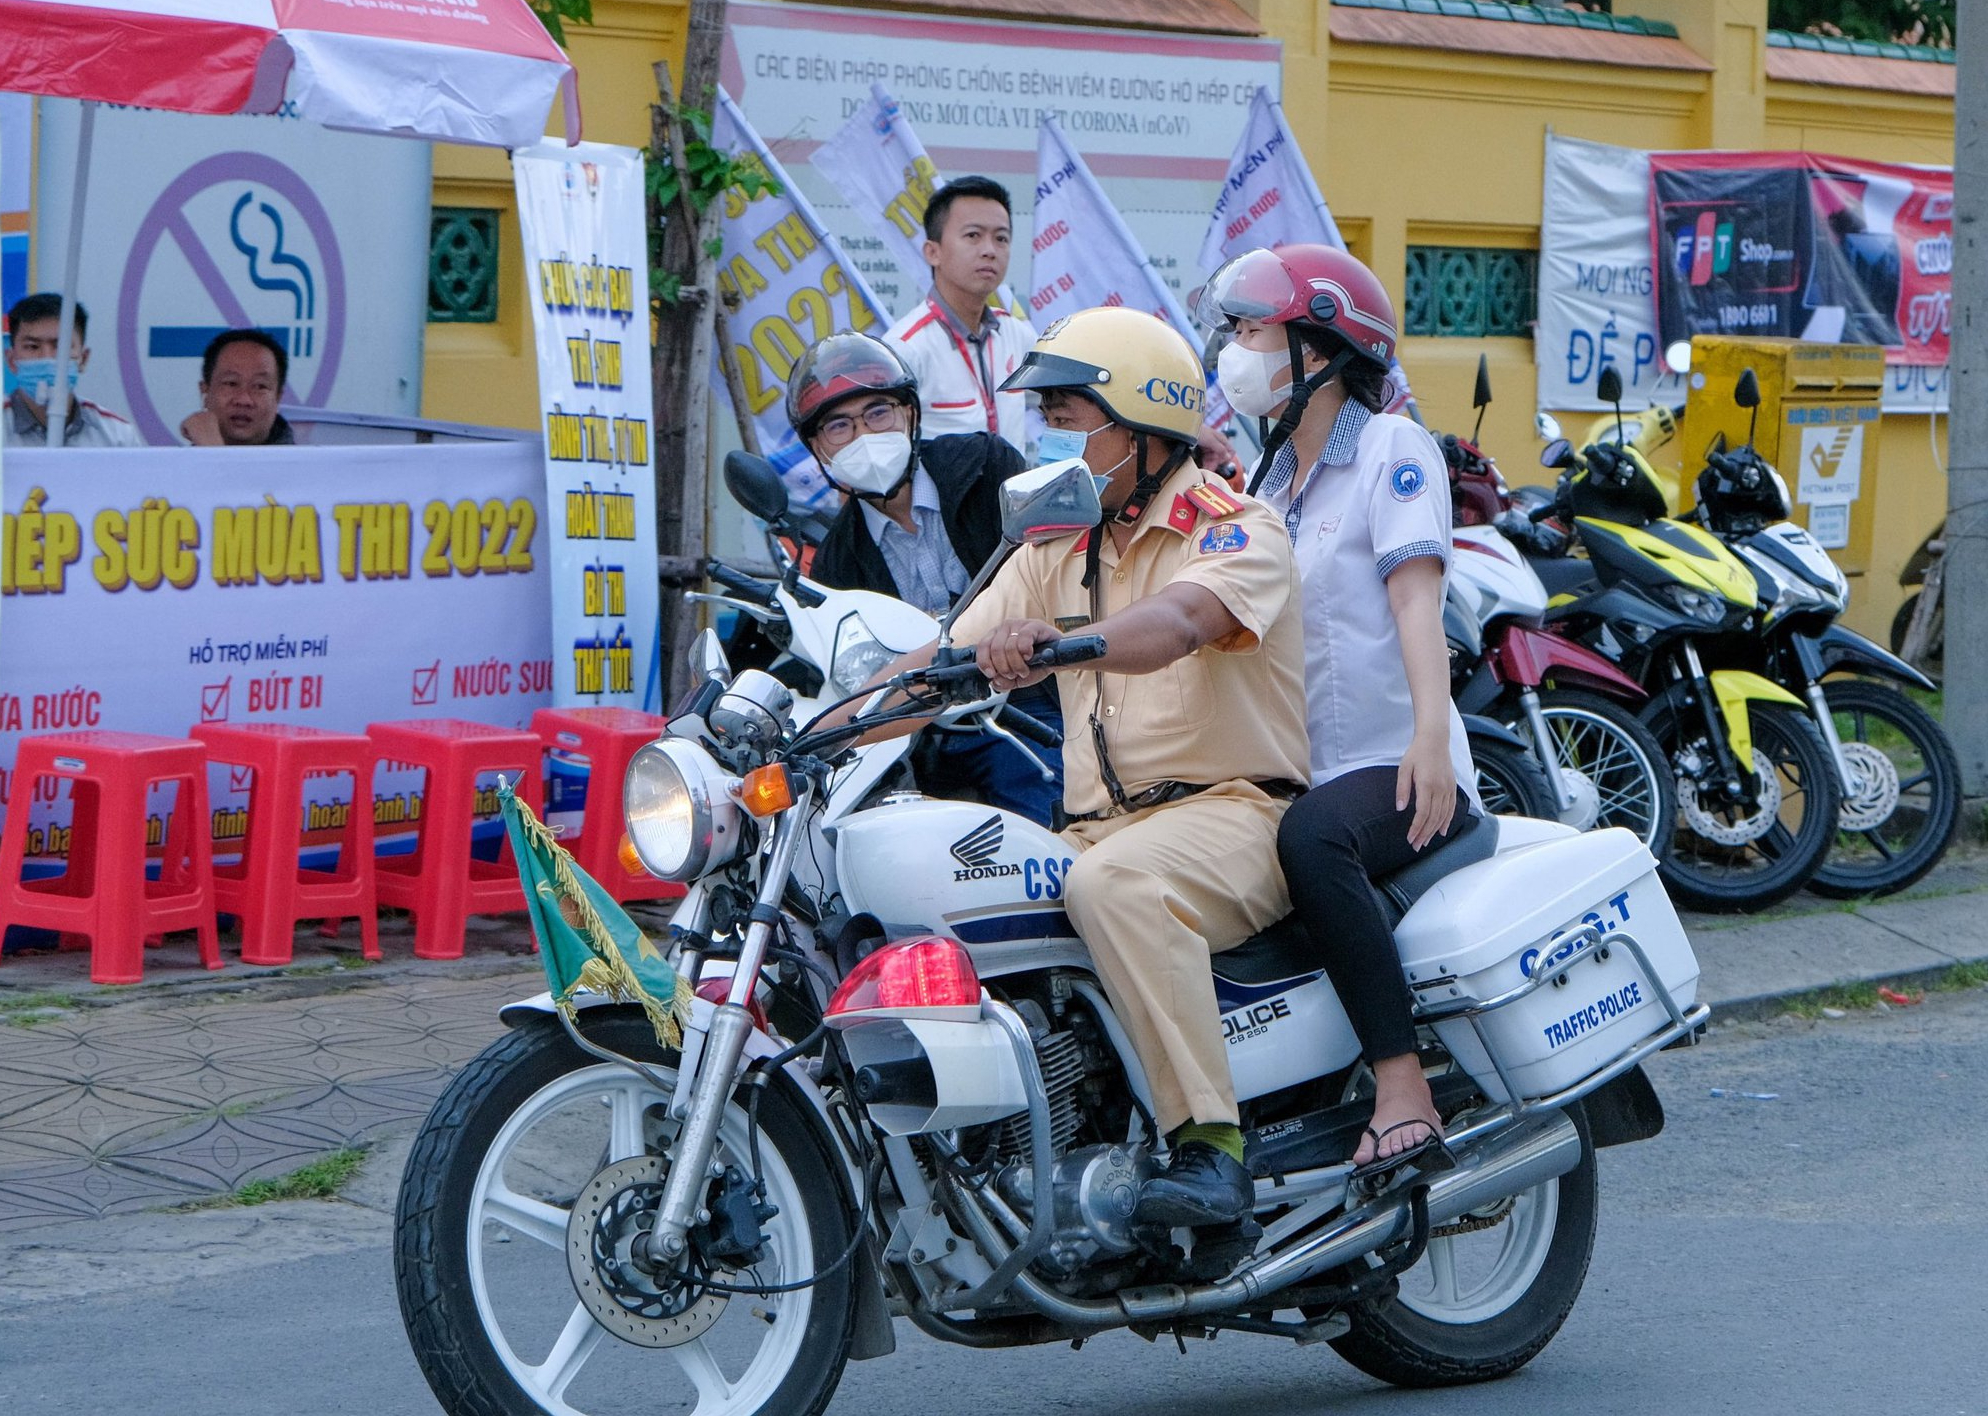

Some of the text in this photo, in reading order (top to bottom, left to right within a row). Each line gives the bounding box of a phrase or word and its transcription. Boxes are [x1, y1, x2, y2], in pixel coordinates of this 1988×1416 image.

[755, 50, 790, 79] CÁC
[796, 52, 836, 86] BIỆN
[1019, 69, 1063, 98] BỆNH
[1066, 71, 1105, 98] VIÊM
[1233, 78, 1254, 106] CẤ
[1013, 107, 1030, 129] VI
[1071, 109, 1138, 133] CORONA
[1142, 113, 1190, 138] (nCoV)
[1056, 272, 1076, 293] BI
[1622, 266, 1653, 296] NG
[2, 485, 537, 596] IẾP SỨC MÙA THI 2022
[189, 634, 329, 666] HỖ TRỢ MIỄN PHÍ
[247, 670, 323, 713] BÚT BI
[452, 655, 553, 698] NƯỚC SU
[32, 684, 102, 730] RƯỚC
[374, 793, 405, 825] ành
[953, 863, 1023, 882] HONDA
[1024, 857, 1074, 901] CS
[1543, 981, 1643, 1049] TRAFFIC POLICE
[1229, 1024, 1269, 1046] CB 250
